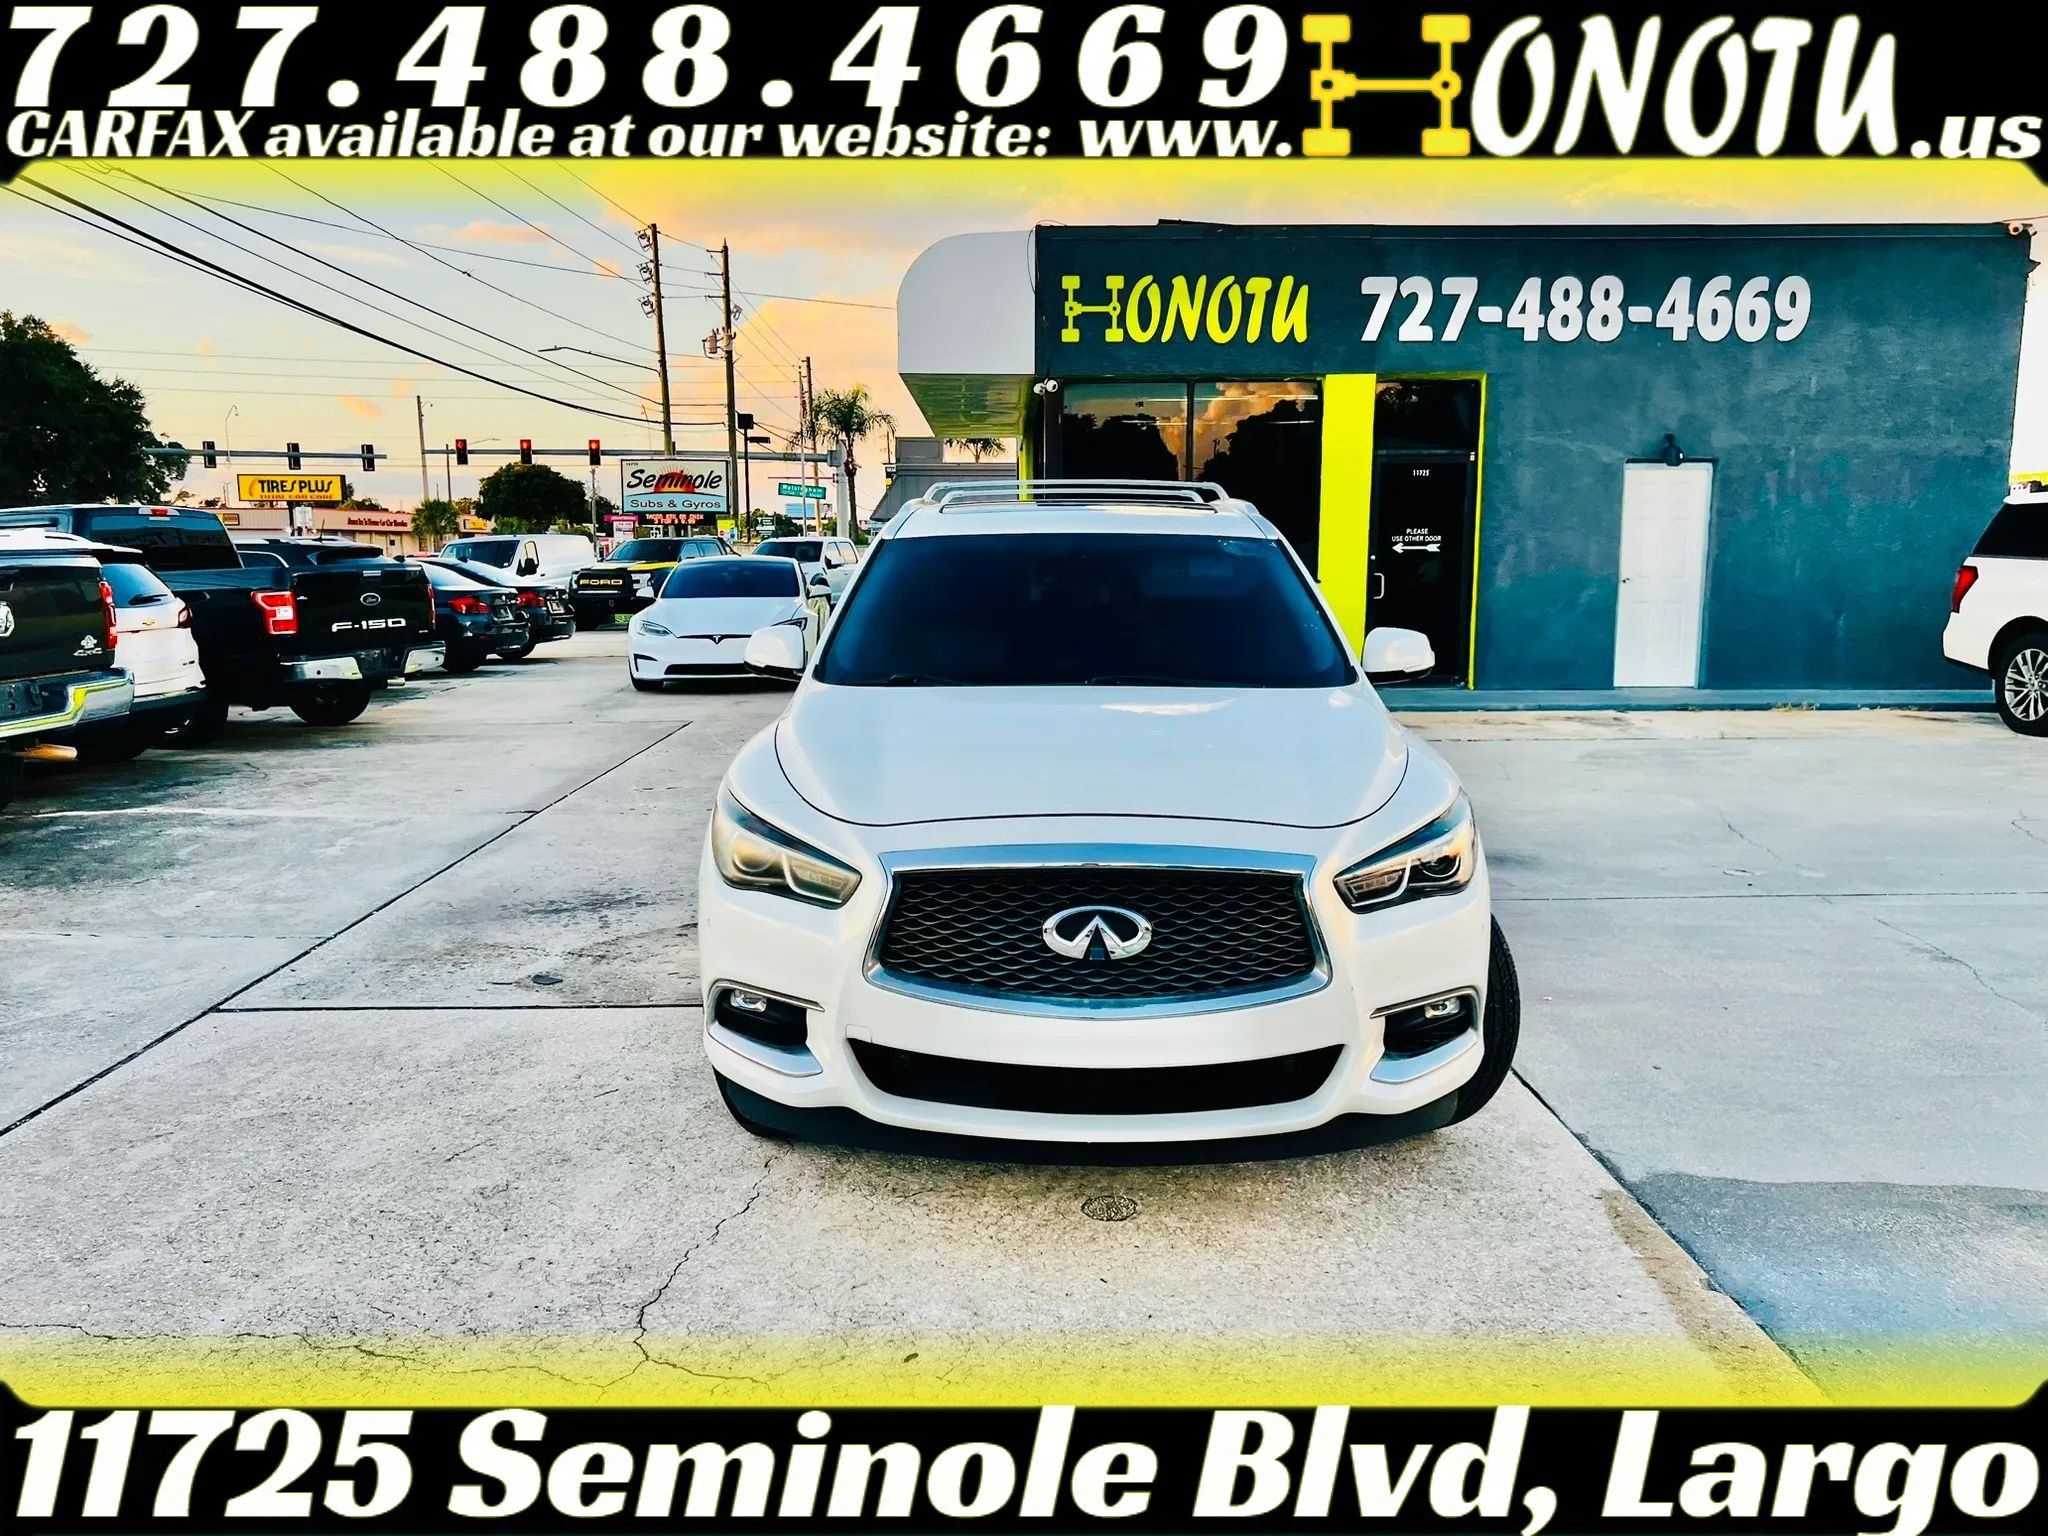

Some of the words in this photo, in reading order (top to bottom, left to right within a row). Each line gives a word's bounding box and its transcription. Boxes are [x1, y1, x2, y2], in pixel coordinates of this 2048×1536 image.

[1062, 274, 1309, 344] HONOTU
[1360, 275, 1812, 344] 727-488-4669
[626, 469, 723, 489] Seminole
[1413, 469, 1430, 477] 11725
[258, 480, 296, 493] TIRES
[299, 480, 333, 493] PLUS
[630, 500, 663, 508] Subs
[668, 500, 677, 508] &
[682, 500, 721, 510] Gyros
[331, 618, 406, 632] F-150
